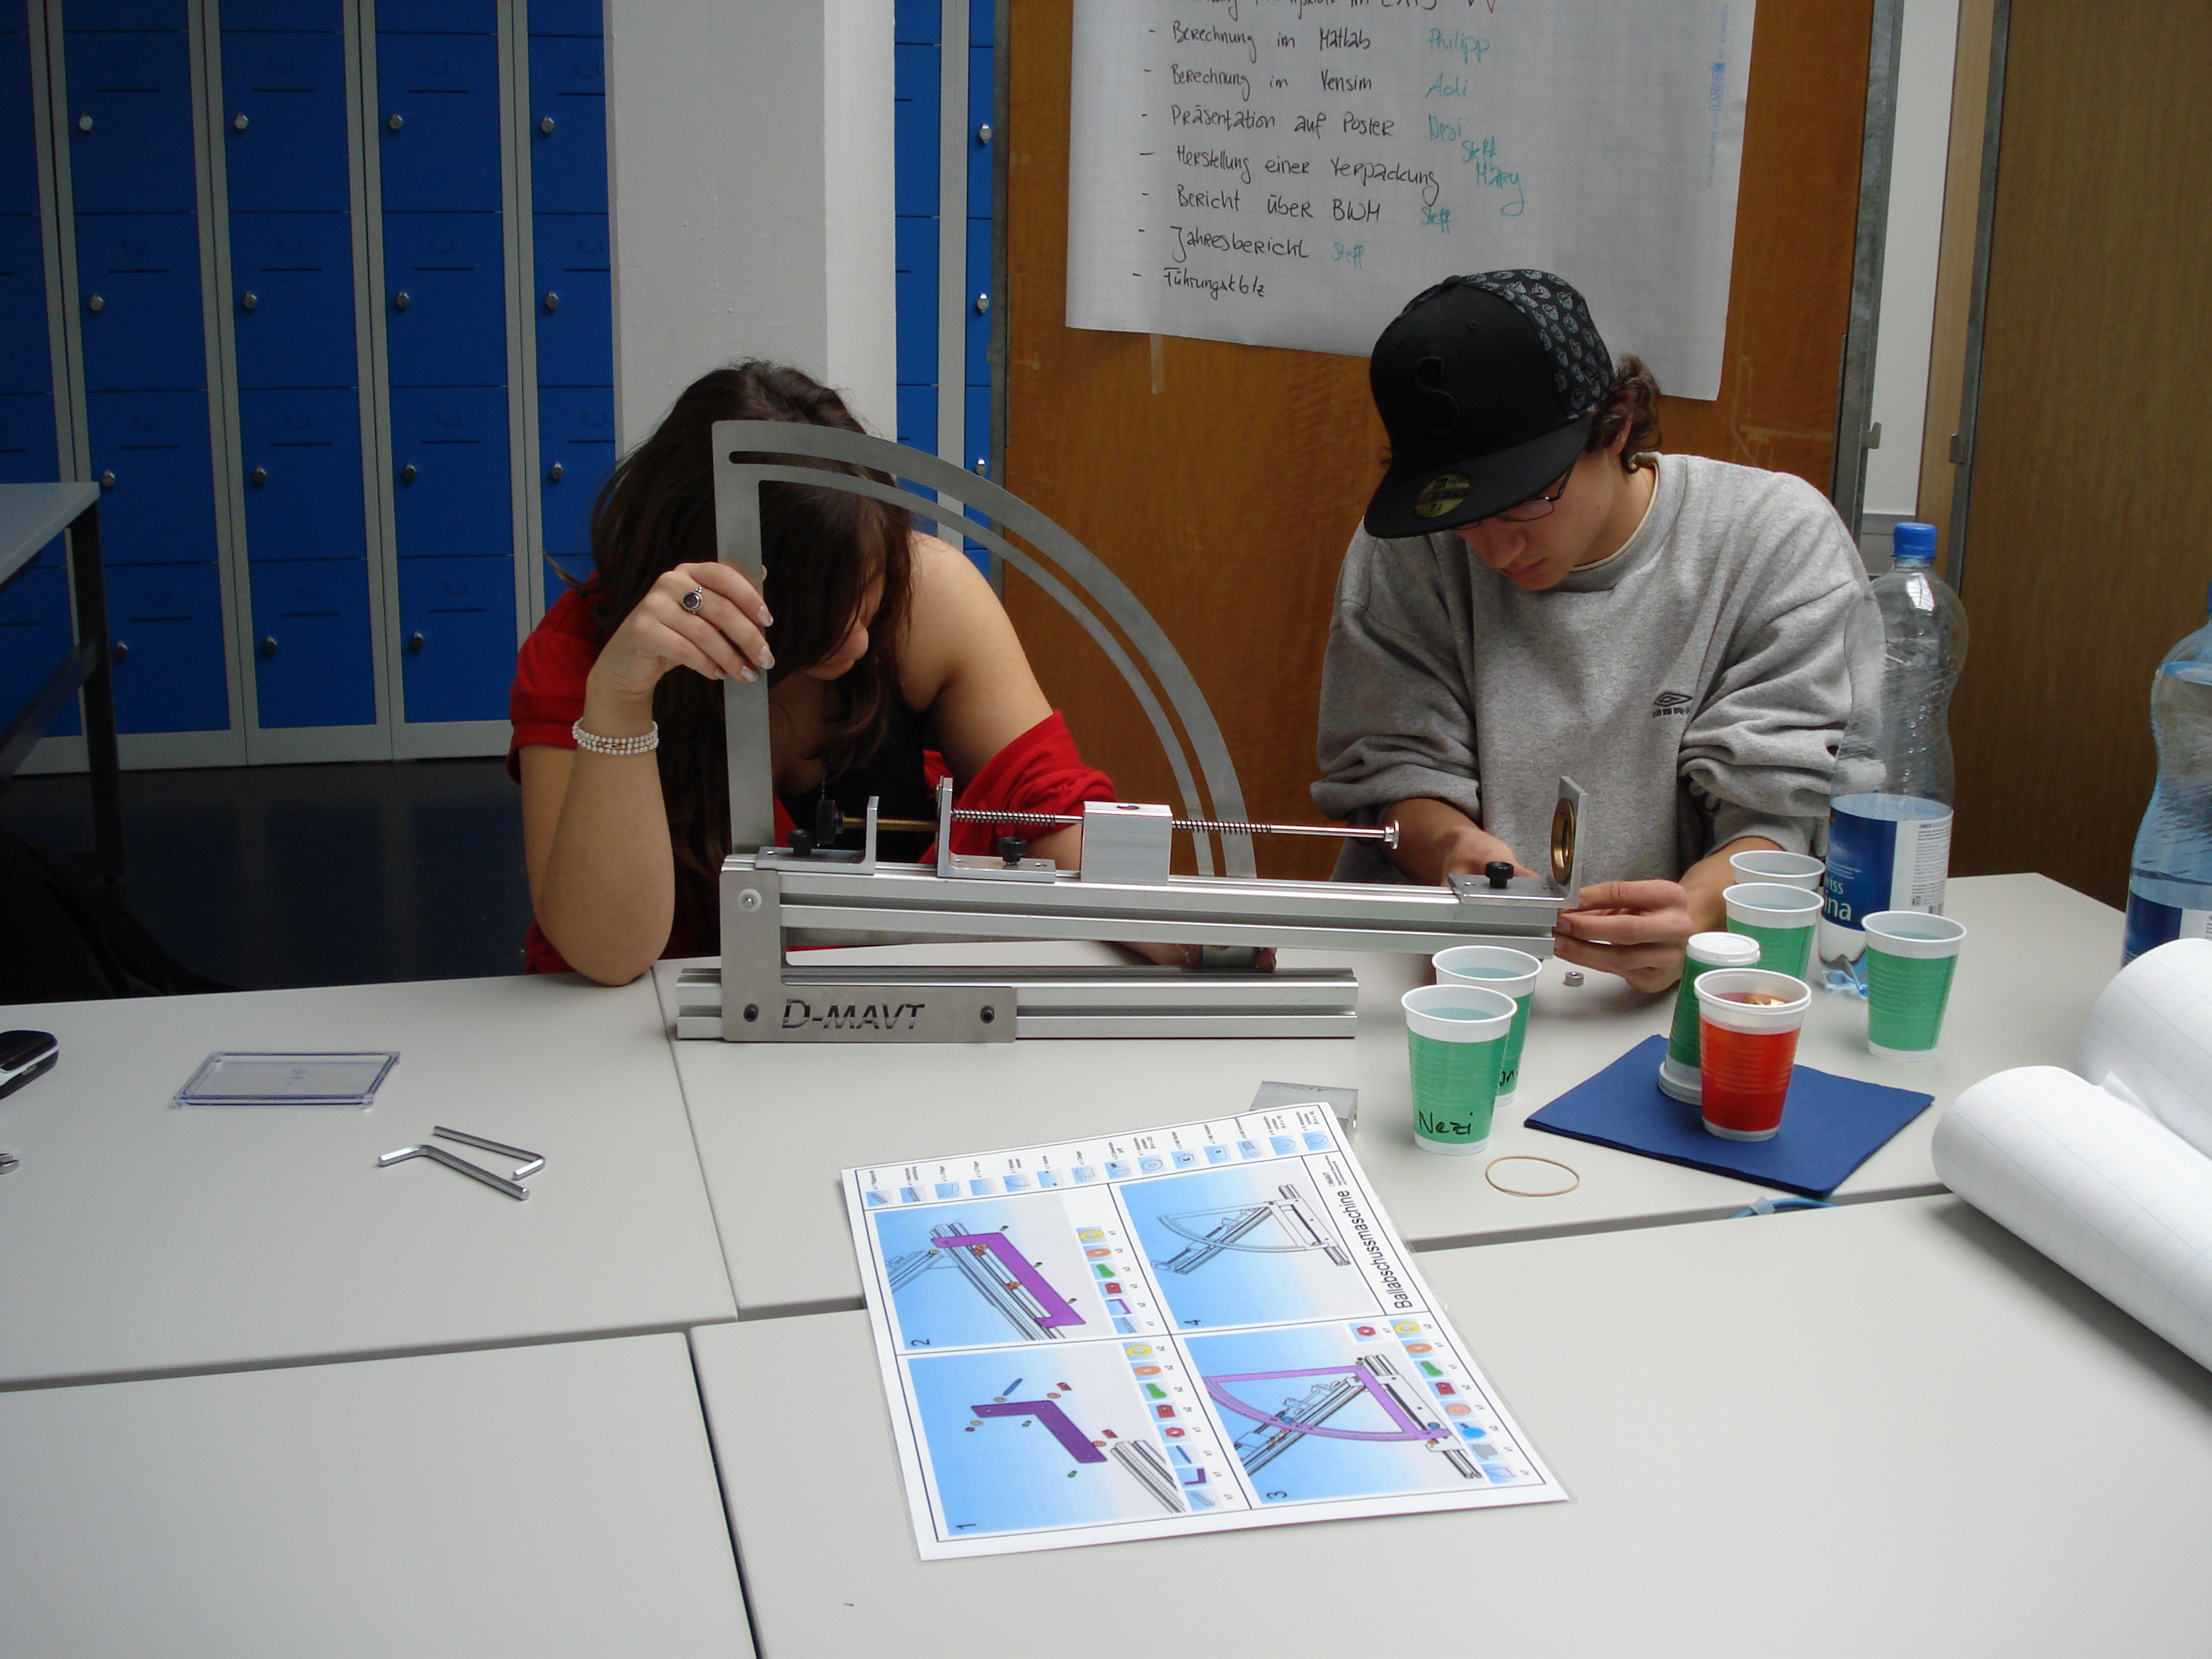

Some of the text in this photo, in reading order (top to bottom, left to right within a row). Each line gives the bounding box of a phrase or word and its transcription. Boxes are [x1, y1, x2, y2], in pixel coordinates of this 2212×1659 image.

[1173, 25, 1256, 63] Berechnung
[1277, 31, 1296, 48] im
[1429, 27, 1491, 65] Philipp
[1172, 64, 1251, 102] Berechnung
[1269, 76, 1289, 89] im
[1172, 104, 1277, 131] Präsentation
[1294, 115, 1326, 138] auf
[1343, 114, 1395, 138] Poster
[1177, 145, 1251, 184] Herstellung
[1264, 155, 1309, 176] einer
[1331, 157, 1439, 207] Verpackung
[1177, 184, 1241, 212] Bericht
[1267, 194, 1314, 218] über
[1170, 225, 1309, 263] Jahresbericht
[782, 998, 925, 1030] D-MAVT
[1336, 1190, 1414, 1309] Ballabschussmaschine
[1266, 1491, 1287, 1499] 3
